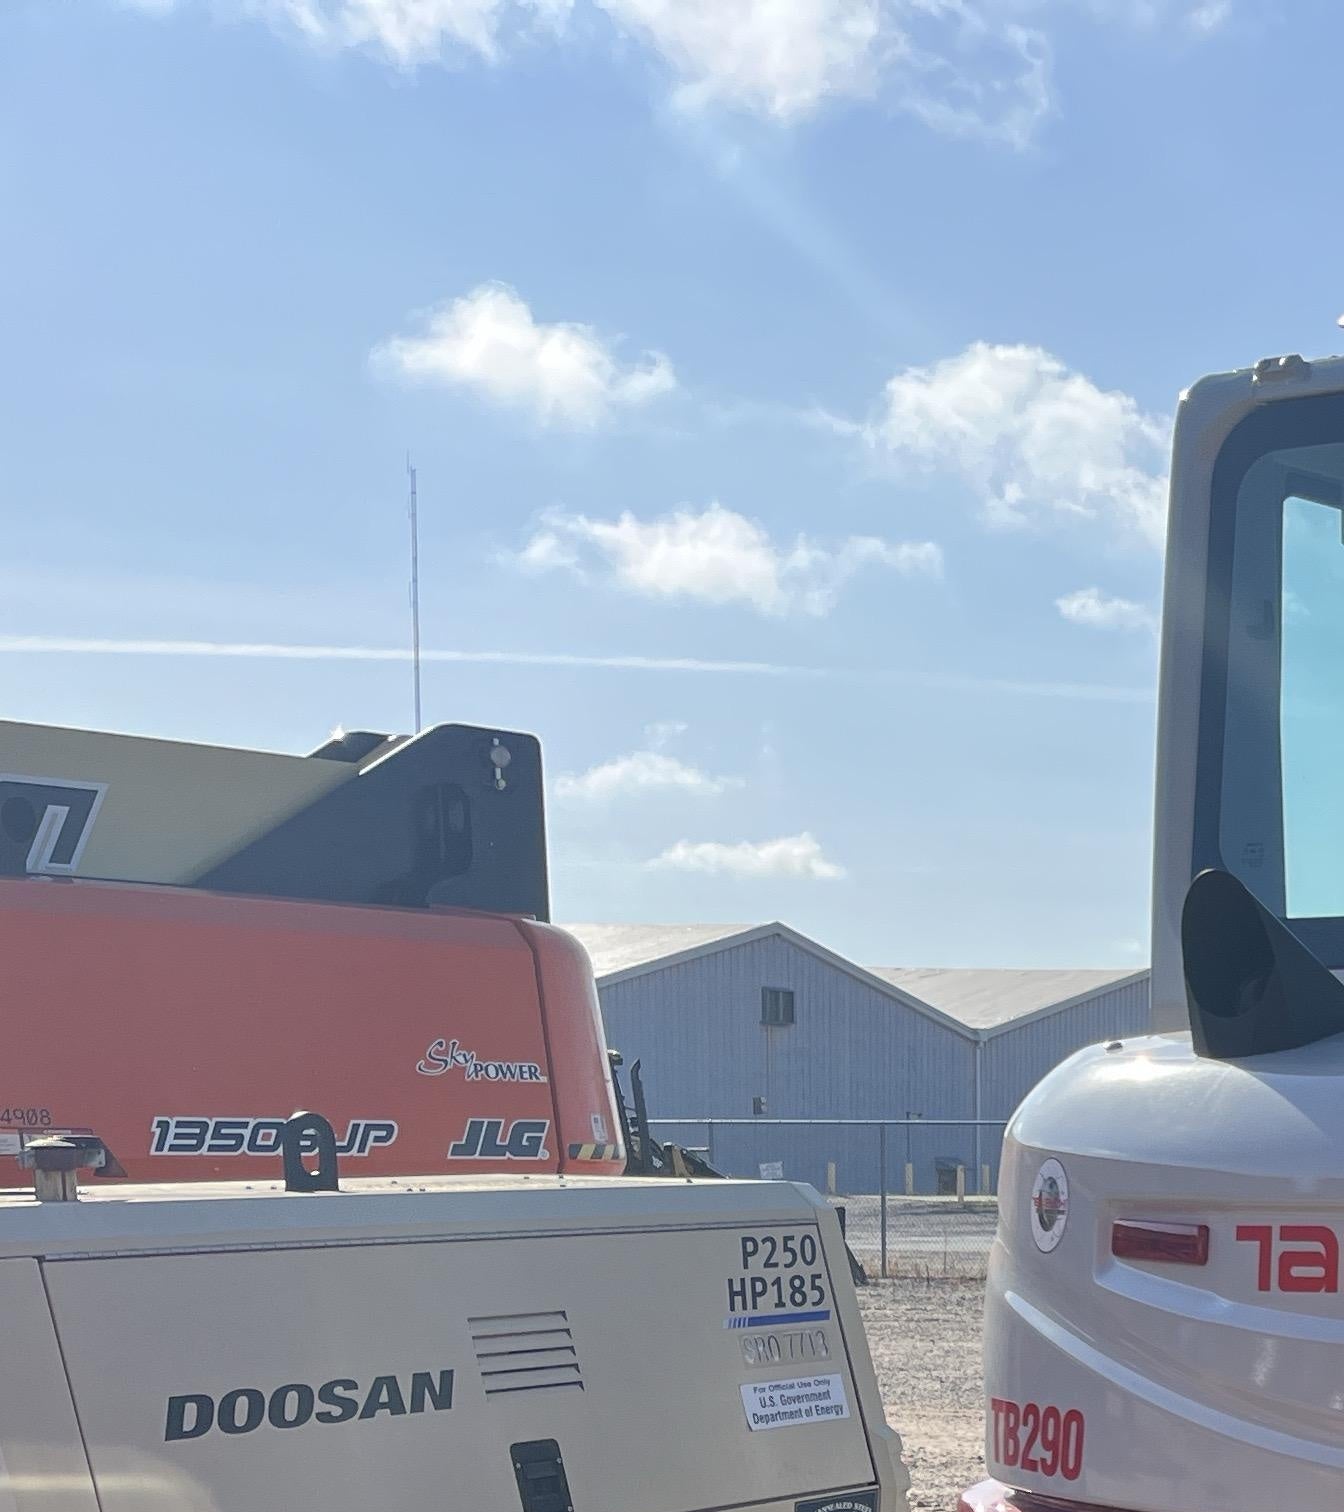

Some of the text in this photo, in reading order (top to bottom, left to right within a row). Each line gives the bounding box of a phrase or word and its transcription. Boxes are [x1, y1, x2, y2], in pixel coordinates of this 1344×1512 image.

[448, 1117, 550, 1160] JLG
[741, 1234, 817, 1269] P250
[727, 1273, 825, 1312] HP185
[165, 1369, 454, 1441] DOOSAN
[752, 1404, 844, 1425] Department of Energy
[759, 1389, 832, 1409] U.S. Government
[991, 1398, 1085, 1481] TB290
